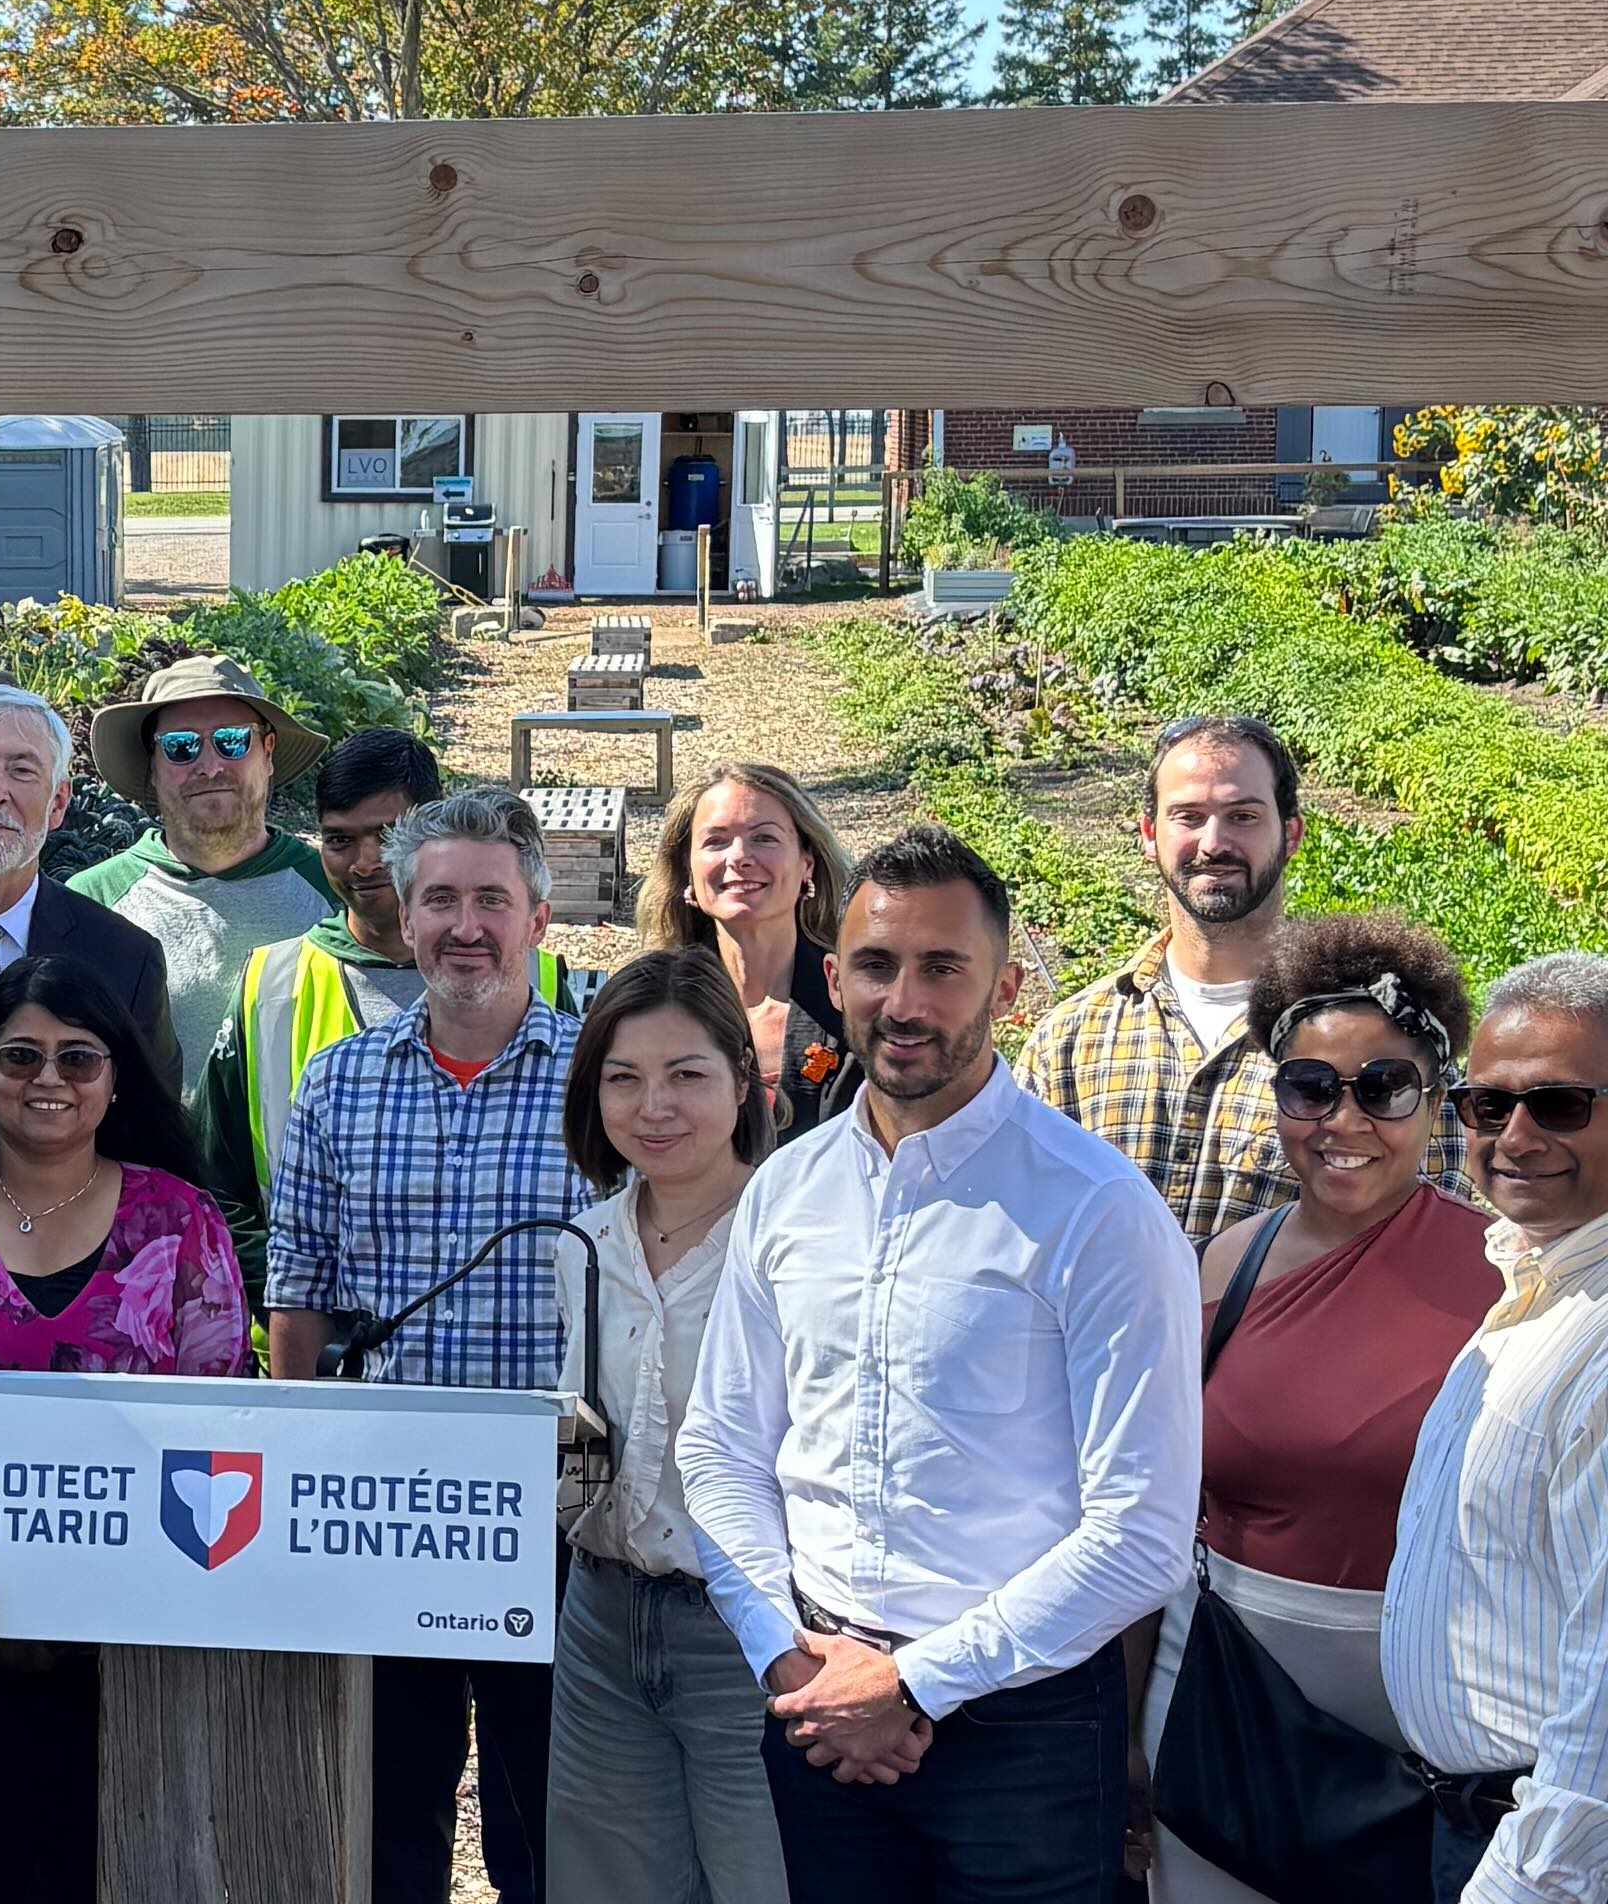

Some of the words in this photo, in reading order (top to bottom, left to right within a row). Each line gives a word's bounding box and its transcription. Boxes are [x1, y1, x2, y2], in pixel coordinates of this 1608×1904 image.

[348, 457, 387, 474] LVO
[290, 1468, 522, 1517] PROTÉGER
[289, 1518, 519, 1562] L'ONTARIO
[417, 1611, 499, 1631] Ontario
